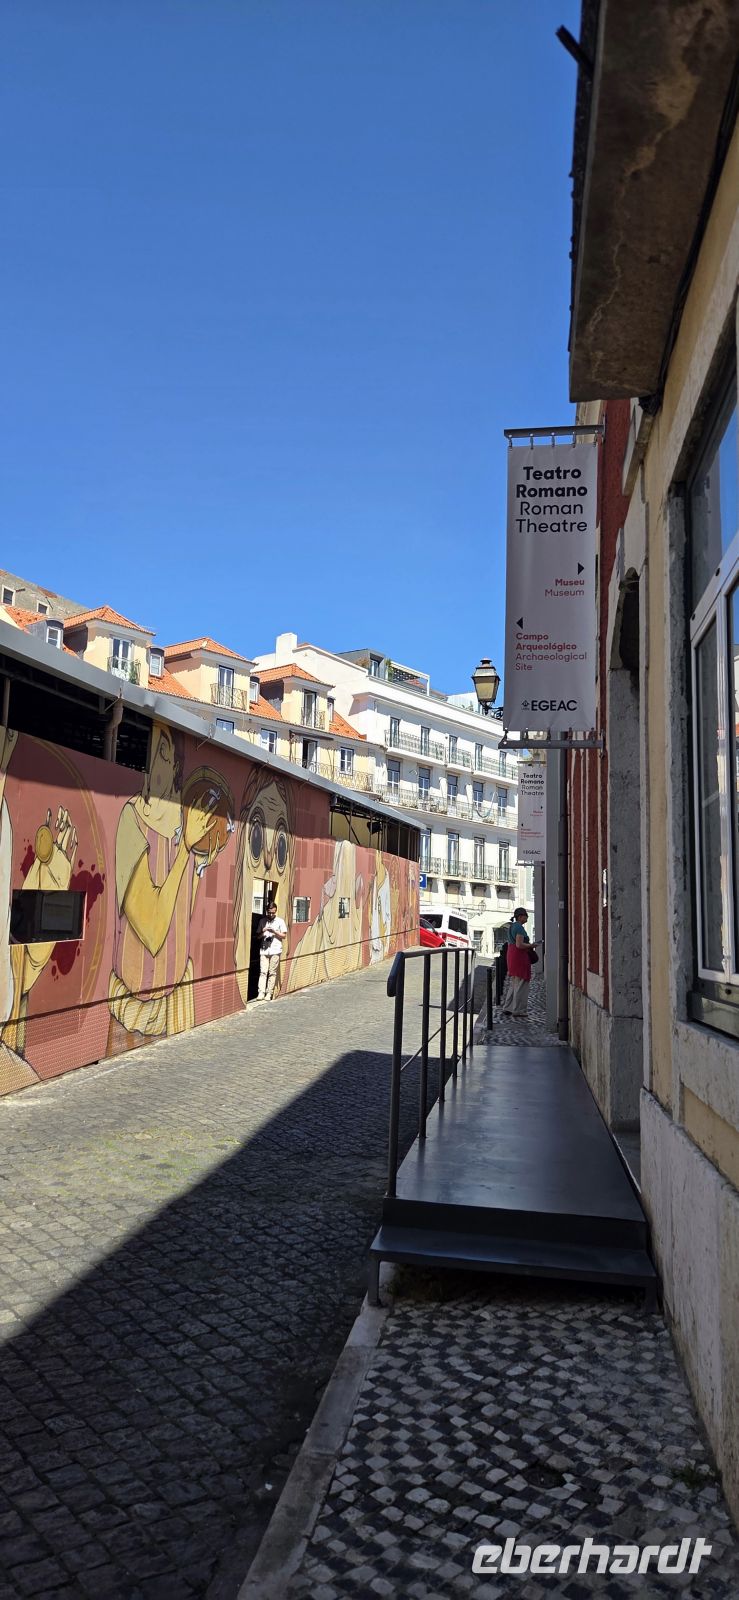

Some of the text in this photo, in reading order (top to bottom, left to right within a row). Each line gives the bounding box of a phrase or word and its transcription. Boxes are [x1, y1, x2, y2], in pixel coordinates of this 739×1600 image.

[523, 466, 581, 480] Teatro
[516, 484, 588, 498] Romano
[520, 501, 583, 515] Roman
[516, 519, 588, 533] Theatre
[545, 589, 584, 597] Museum
[516, 633, 549, 642] Campo
[516, 642, 577, 652] Arqueológico
[515, 652, 587, 662] Archaeological
[515, 663, 533, 671] Site
[531, 700, 578, 711] EGEAC
